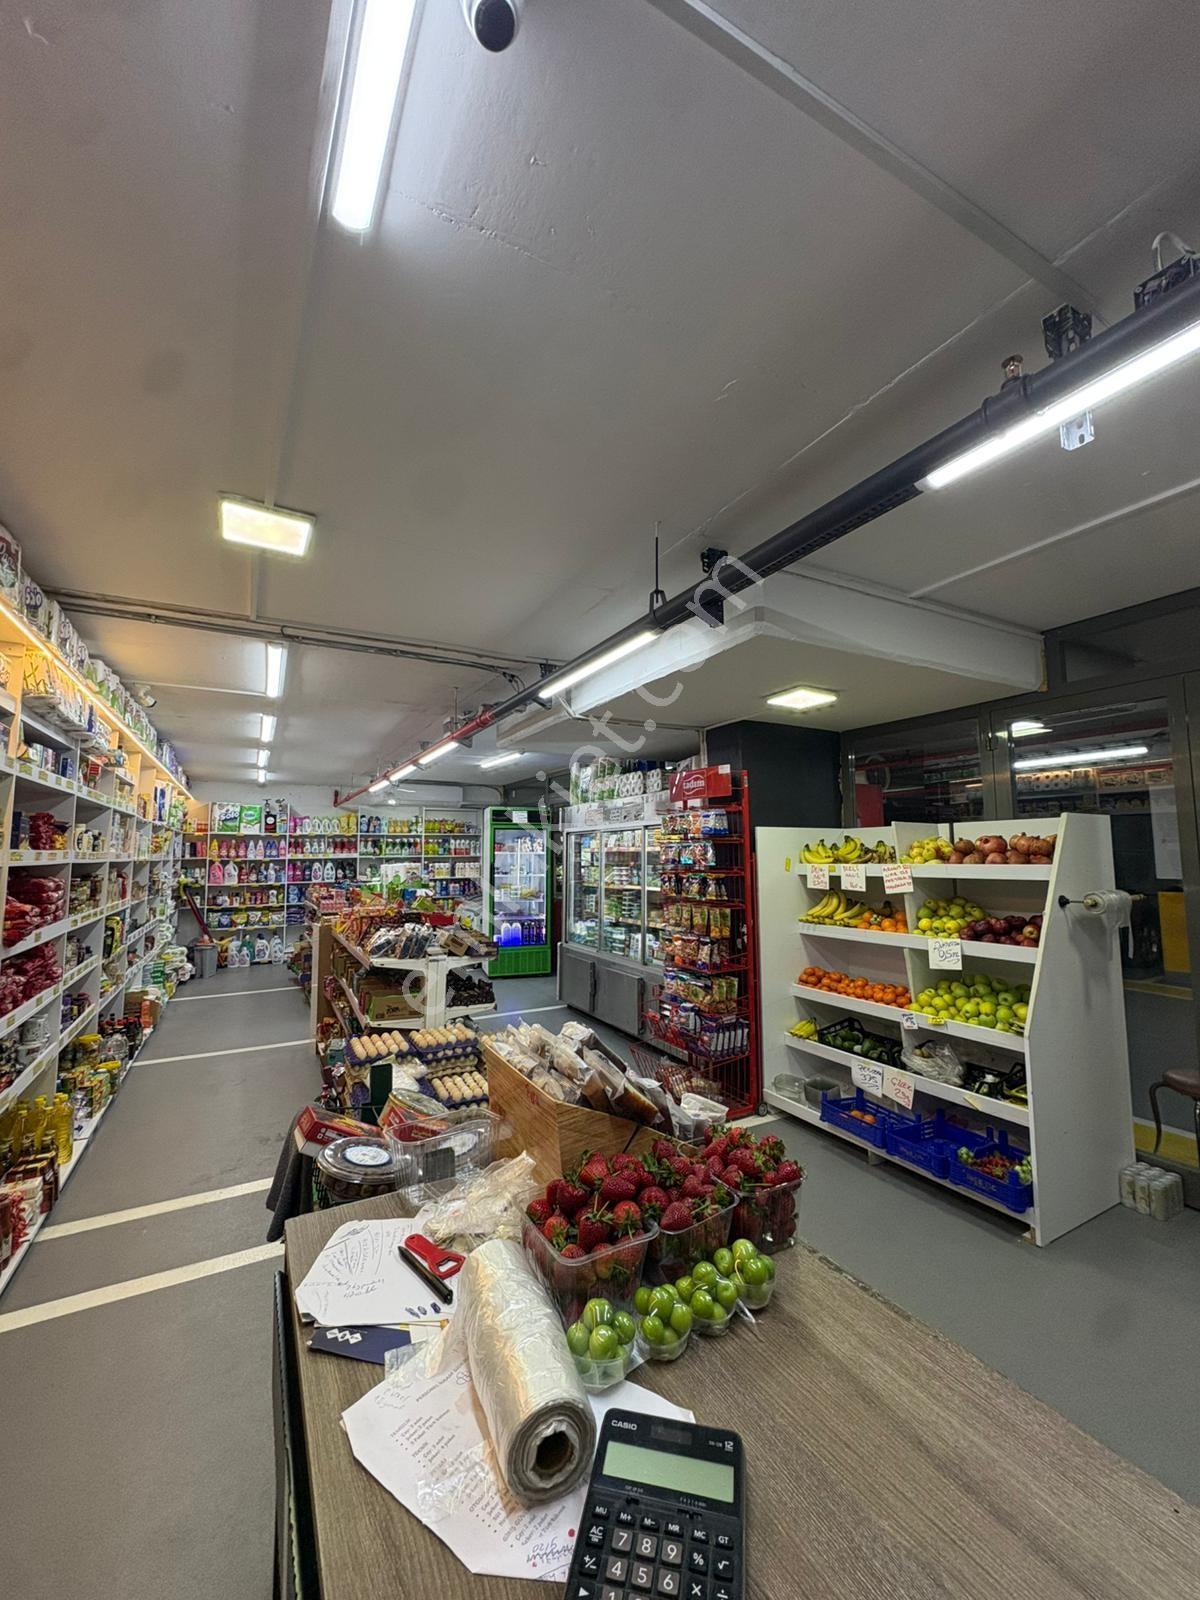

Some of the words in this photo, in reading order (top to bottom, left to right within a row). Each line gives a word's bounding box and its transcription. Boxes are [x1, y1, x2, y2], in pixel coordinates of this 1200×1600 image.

[611, 1420, 638, 1431] CASIO
[595, 1505, 608, 1515] MU
[619, 1512, 632, 1521] M+
[589, 1525, 603, 1536] AC
[668, 1523, 680, 1532] MR
[617, 1532, 628, 1547] 7
[693, 1530, 706, 1540] MC
[718, 1535, 729, 1544] GT
[641, 1538, 652, 1553] 8
[667, 1544, 677, 1560] 9
[611, 1561, 622, 1577] 4
[637, 1567, 647, 1584] 5
[663, 1574, 674, 1590] 6
